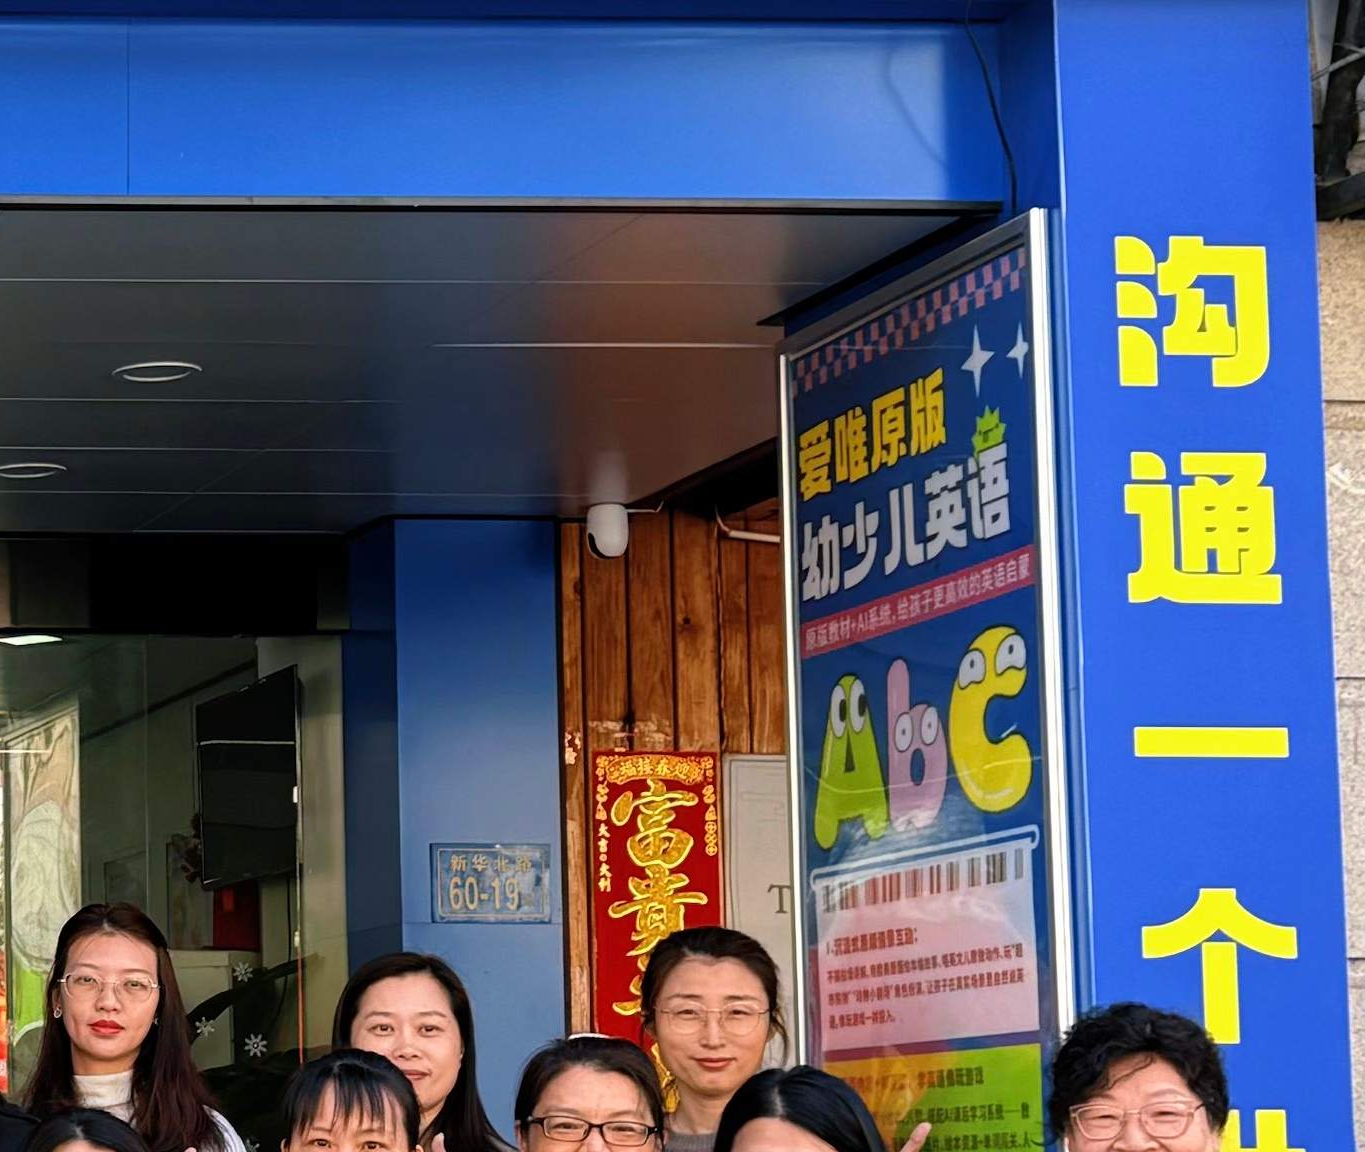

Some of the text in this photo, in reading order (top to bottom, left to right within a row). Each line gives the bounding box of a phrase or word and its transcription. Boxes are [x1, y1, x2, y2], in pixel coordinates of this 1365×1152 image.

[798, 367, 947, 502] 爱唯原版
[800, 443, 1012, 602] 幼少儿英语
[449, 876, 520, 911] 60-19
[450, 853, 534, 873] 新华北路
